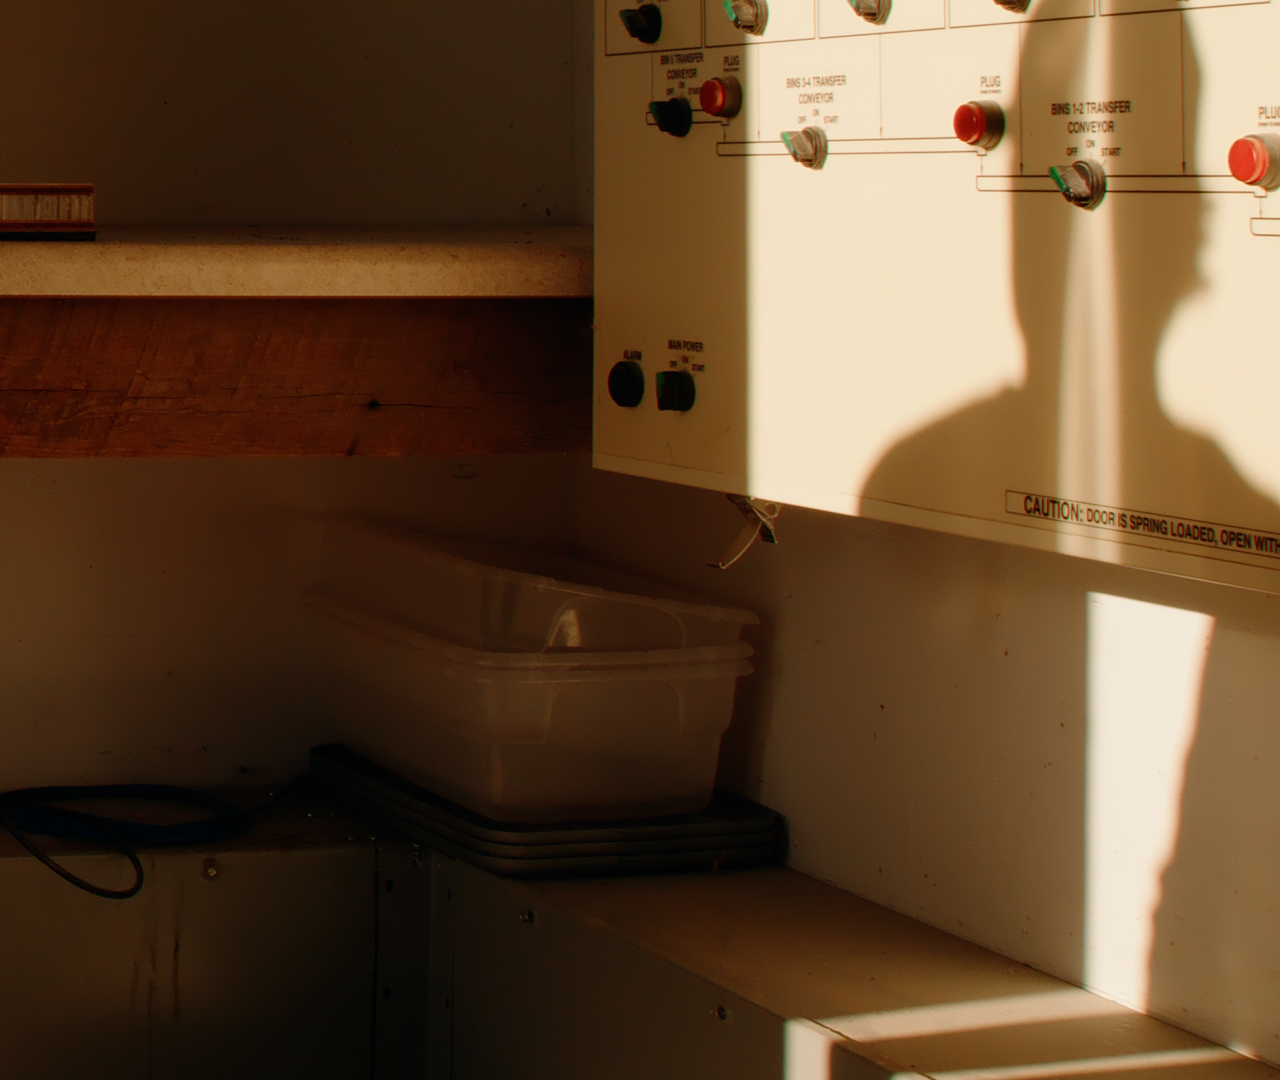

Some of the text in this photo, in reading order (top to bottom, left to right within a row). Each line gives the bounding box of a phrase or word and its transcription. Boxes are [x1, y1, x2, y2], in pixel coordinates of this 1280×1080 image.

[674, 52, 704, 64] TRANSFER
[723, 56, 740, 66] PLUG
[666, 68, 698, 80] CONVEYOR
[786, 74, 846, 88] BINS 3-4 TRANSFER
[980, 75, 1001, 88] PLUG
[798, 92, 834, 104] CONVEYOR
[812, 108, 820, 116] ON
[1051, 100, 1131, 116] BINS 1-2 TRANSFER
[798, 116, 807, 124] OFF
[824, 116, 838, 124] START
[1068, 120, 1114, 134] CONVEYOR
[1086, 139, 1095, 148] ON
[1066, 147, 1079, 156] OFF
[1100, 147, 1121, 156] START
[668, 339, 704, 353] MAIN POWER
[623, 349, 642, 361] ALARM
[1024, 495, 1083, 522] CAUTION:
[1086, 508, 1115, 526] DOOR
[1118, 512, 1128, 529] IS
[1130, 514, 1168, 536] SPRING
[1170, 521, 1218, 547] LOADED,
[1220, 530, 1252, 549] OPEN
